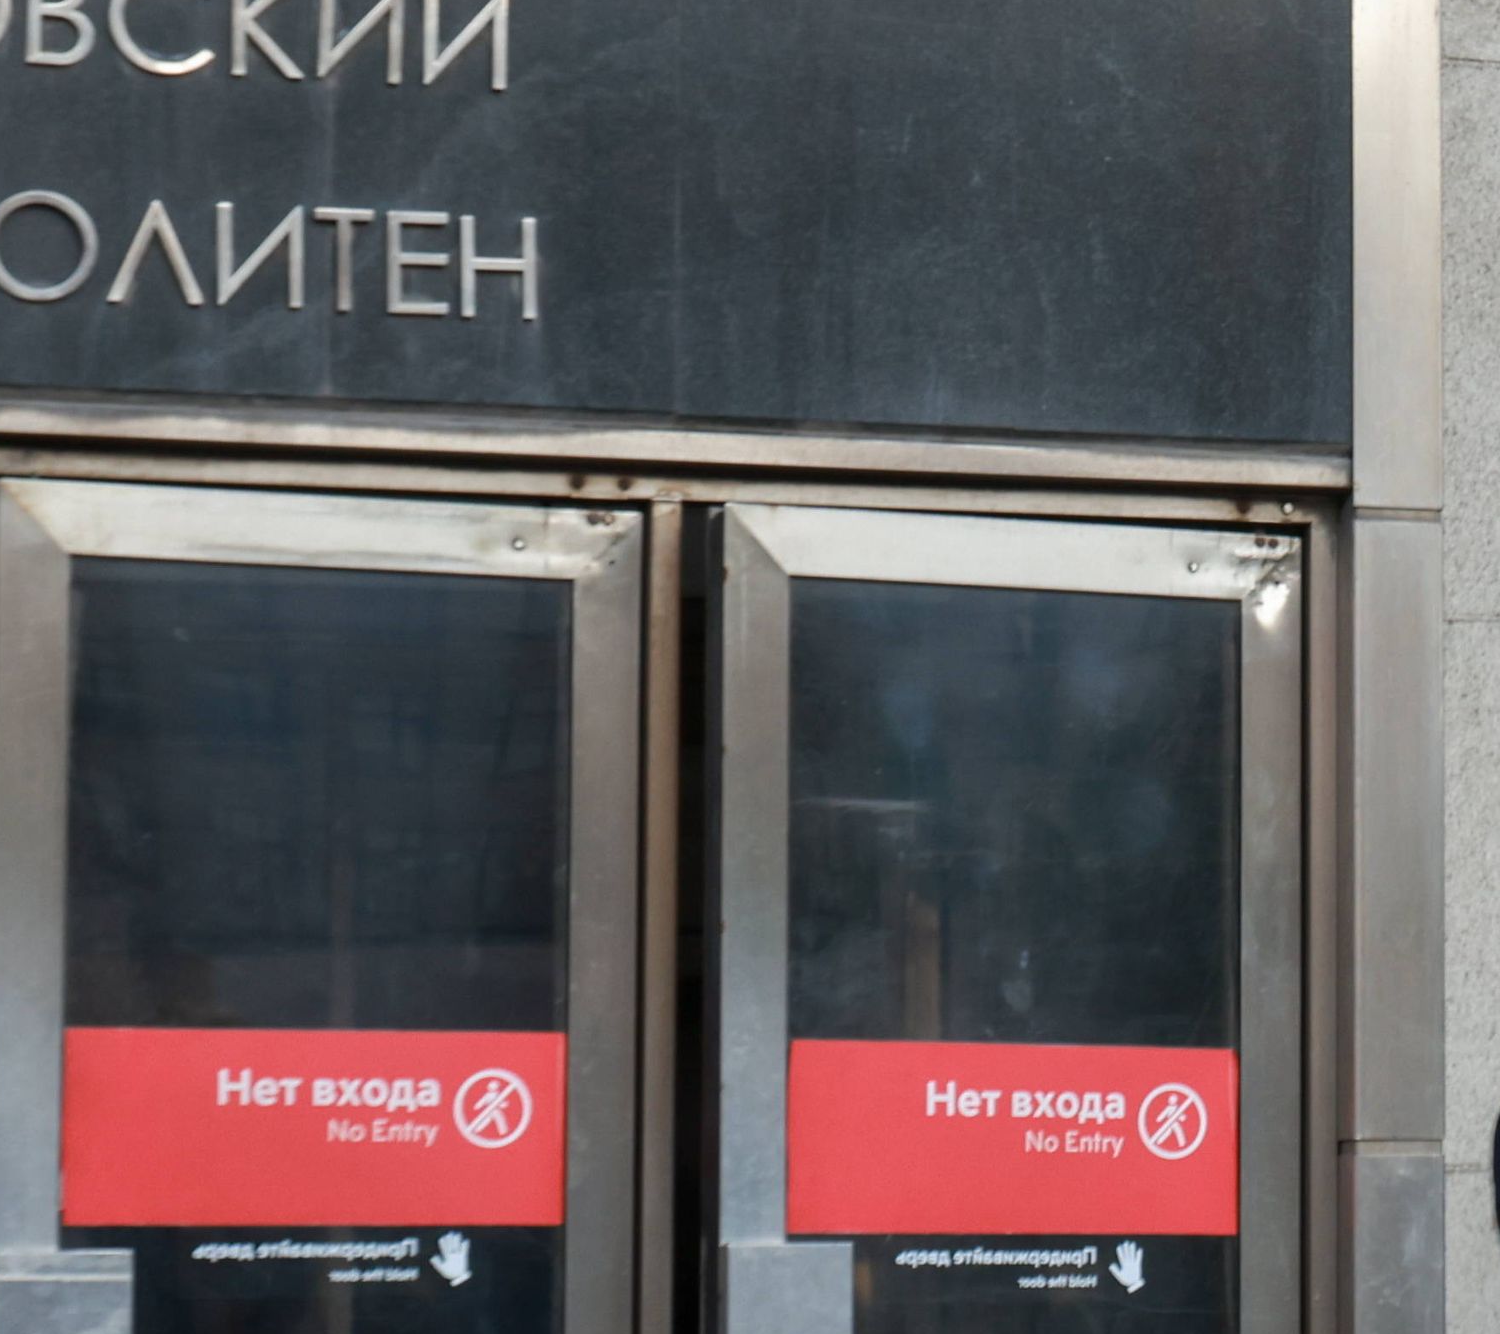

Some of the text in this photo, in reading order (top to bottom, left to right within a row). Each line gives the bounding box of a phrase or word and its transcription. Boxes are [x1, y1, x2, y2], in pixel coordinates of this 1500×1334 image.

[216, 1067, 442, 1114] Нет входа
[925, 1079, 1127, 1126] Нет входа
[326, 1116, 441, 1148] No Entry
[1023, 1128, 1126, 1159] No Entry
